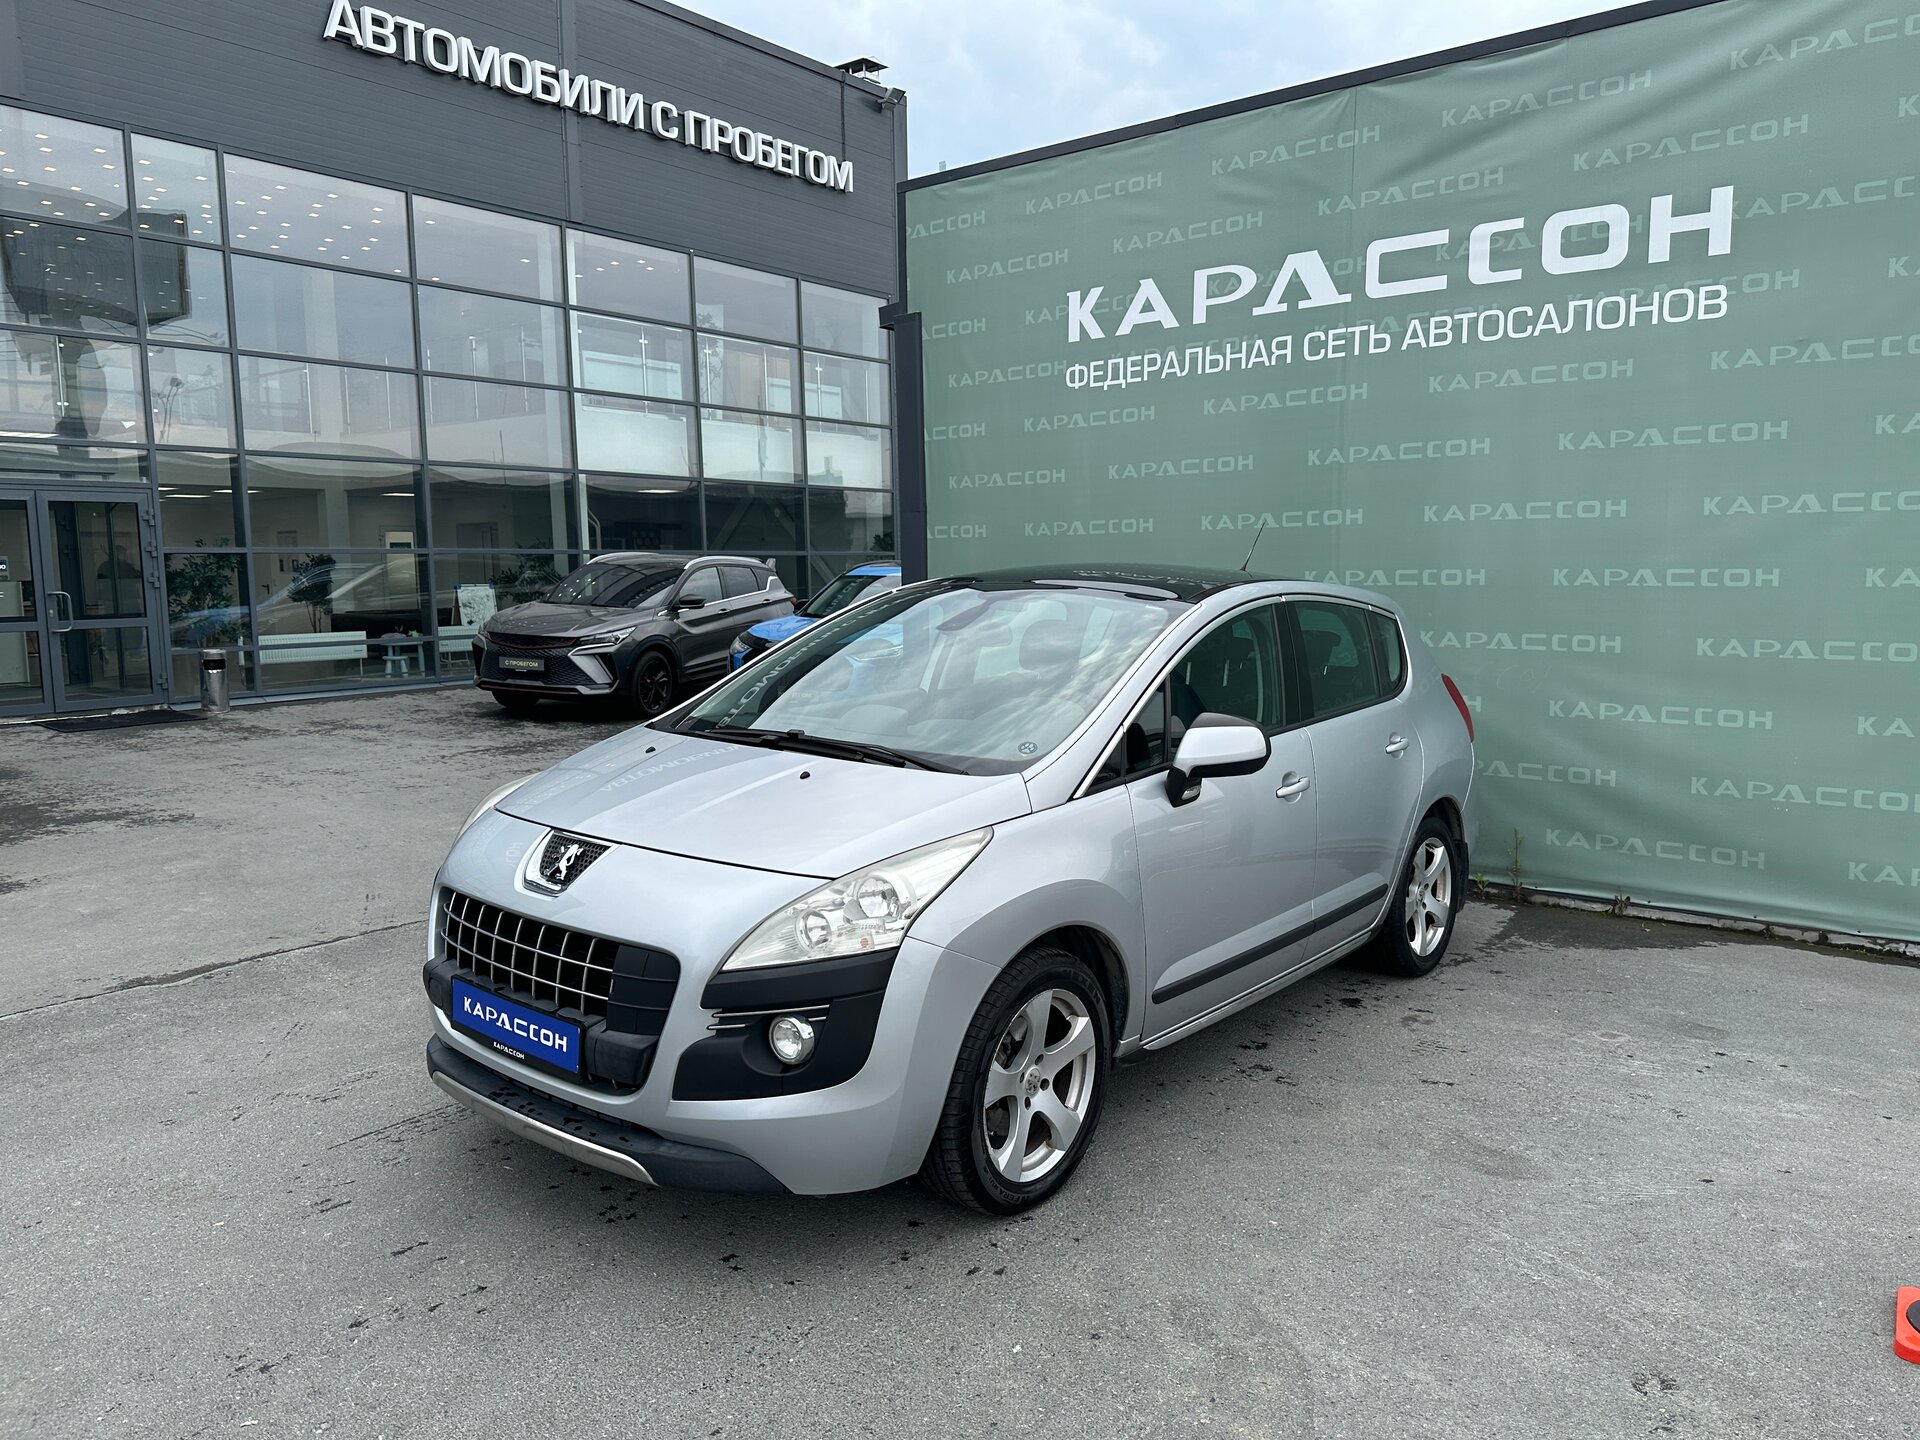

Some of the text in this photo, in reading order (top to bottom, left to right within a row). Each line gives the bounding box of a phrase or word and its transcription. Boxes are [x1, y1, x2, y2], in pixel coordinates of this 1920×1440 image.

[323, 0, 854, 193] АВТОМОБИЛИ С ПРОБЕГОМ
[1066, 185, 1734, 343] КАРАССОН
[1065, 284, 1728, 391] ФЕДЕРАЛЬНАЯ СЕТЬ АВТОСАЛОНОВ
[1690, 776, 1920, 814] КАРАССО
[463, 996, 568, 1053] КАРАССОН
